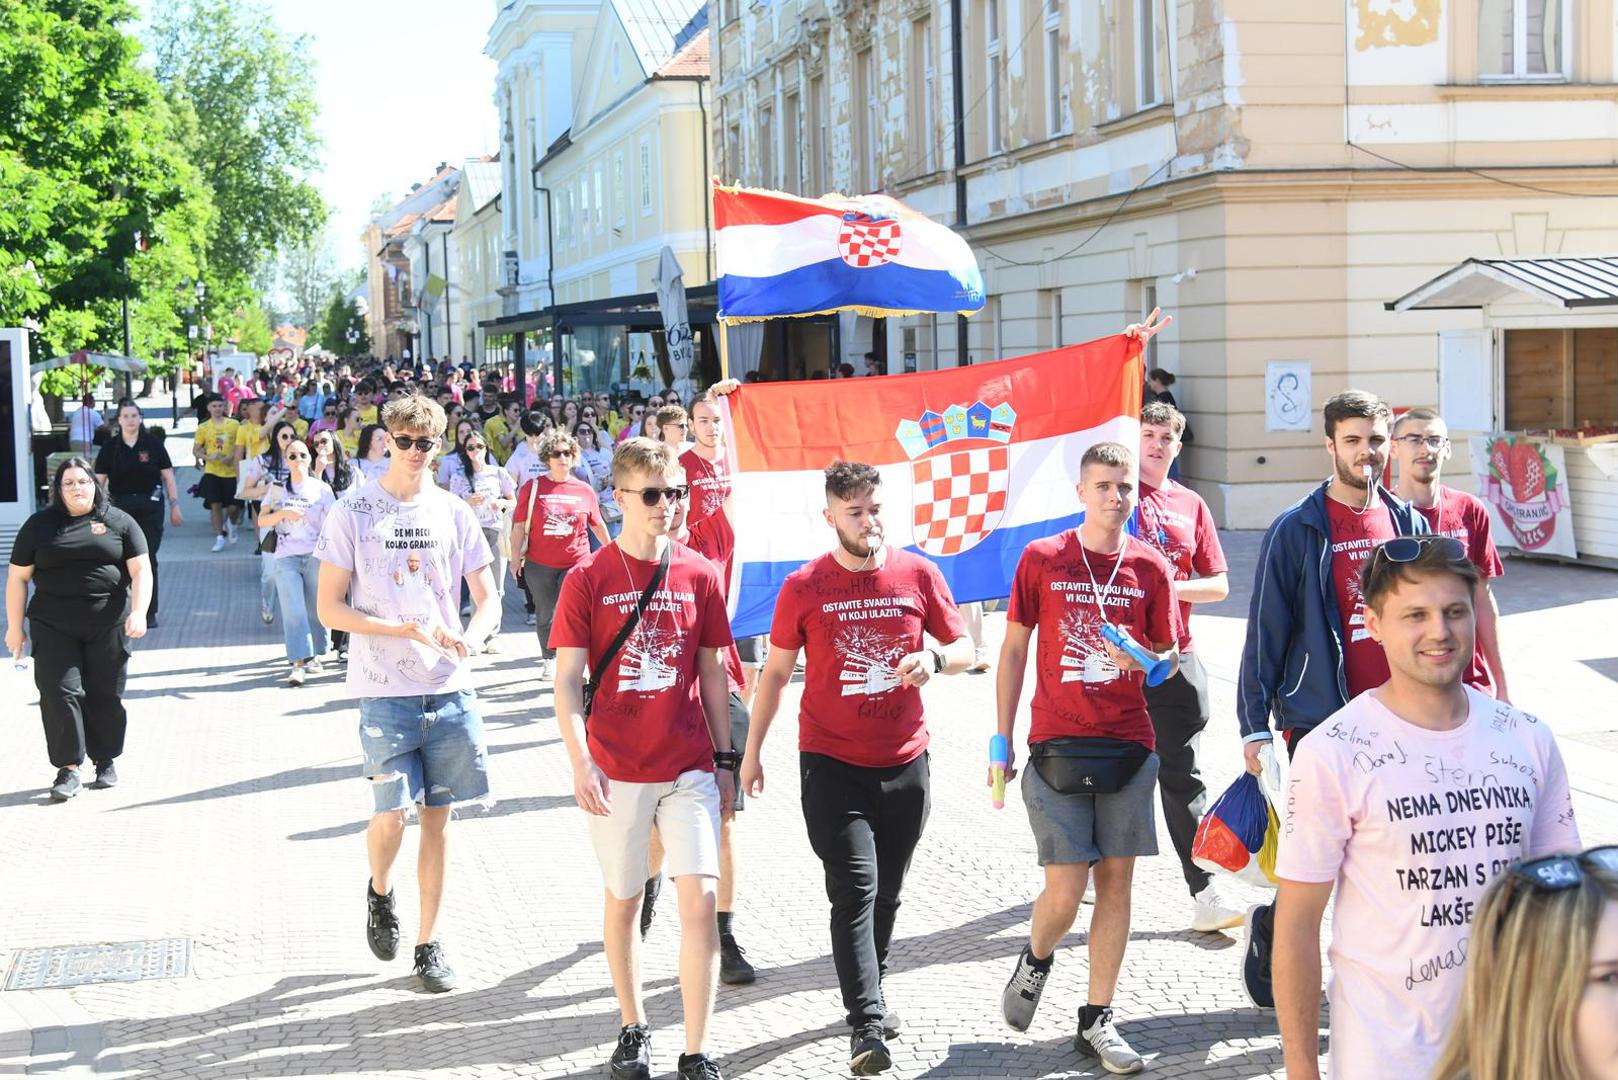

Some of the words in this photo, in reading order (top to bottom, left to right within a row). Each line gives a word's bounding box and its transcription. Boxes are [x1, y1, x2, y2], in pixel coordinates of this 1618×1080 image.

[394, 528, 403, 538] DE
[404, 528, 414, 538] MI
[415, 528, 430, 538] RECI
[385, 540, 408, 550] KOLKO
[1332, 538, 1371, 553] OSTAVITE
[1348, 551, 1358, 561] VI
[651, 590, 673, 601] VAKU
[1051, 581, 1091, 592] OSTAVITE
[1122, 586, 1145, 599] NADU
[822, 599, 862, 613] OSTAVITE
[864, 598, 891, 608] SVAKU
[1065, 593, 1074, 603] VI
[1075, 594, 1095, 604] KOJI
[619, 604, 629, 615] VI
[650, 602, 682, 613] ULAZITE
[838, 613, 847, 622] VI
[848, 610, 868, 621] KOJI
[869, 608, 903, 619] ULAZITE
[1326, 722, 1371, 748] Selina
[1353, 751, 1395, 774] Dora
[1387, 795, 1441, 823] NEMA
[1446, 786, 1534, 812] DNEVNIKA,
[1410, 824, 1477, 856] MICKEY
[1485, 817, 1523, 847] PIŠE
[1396, 867, 1469, 892] TARZAN
[1475, 862, 1487, 886] S
[1421, 896, 1474, 928] LAKŠE
